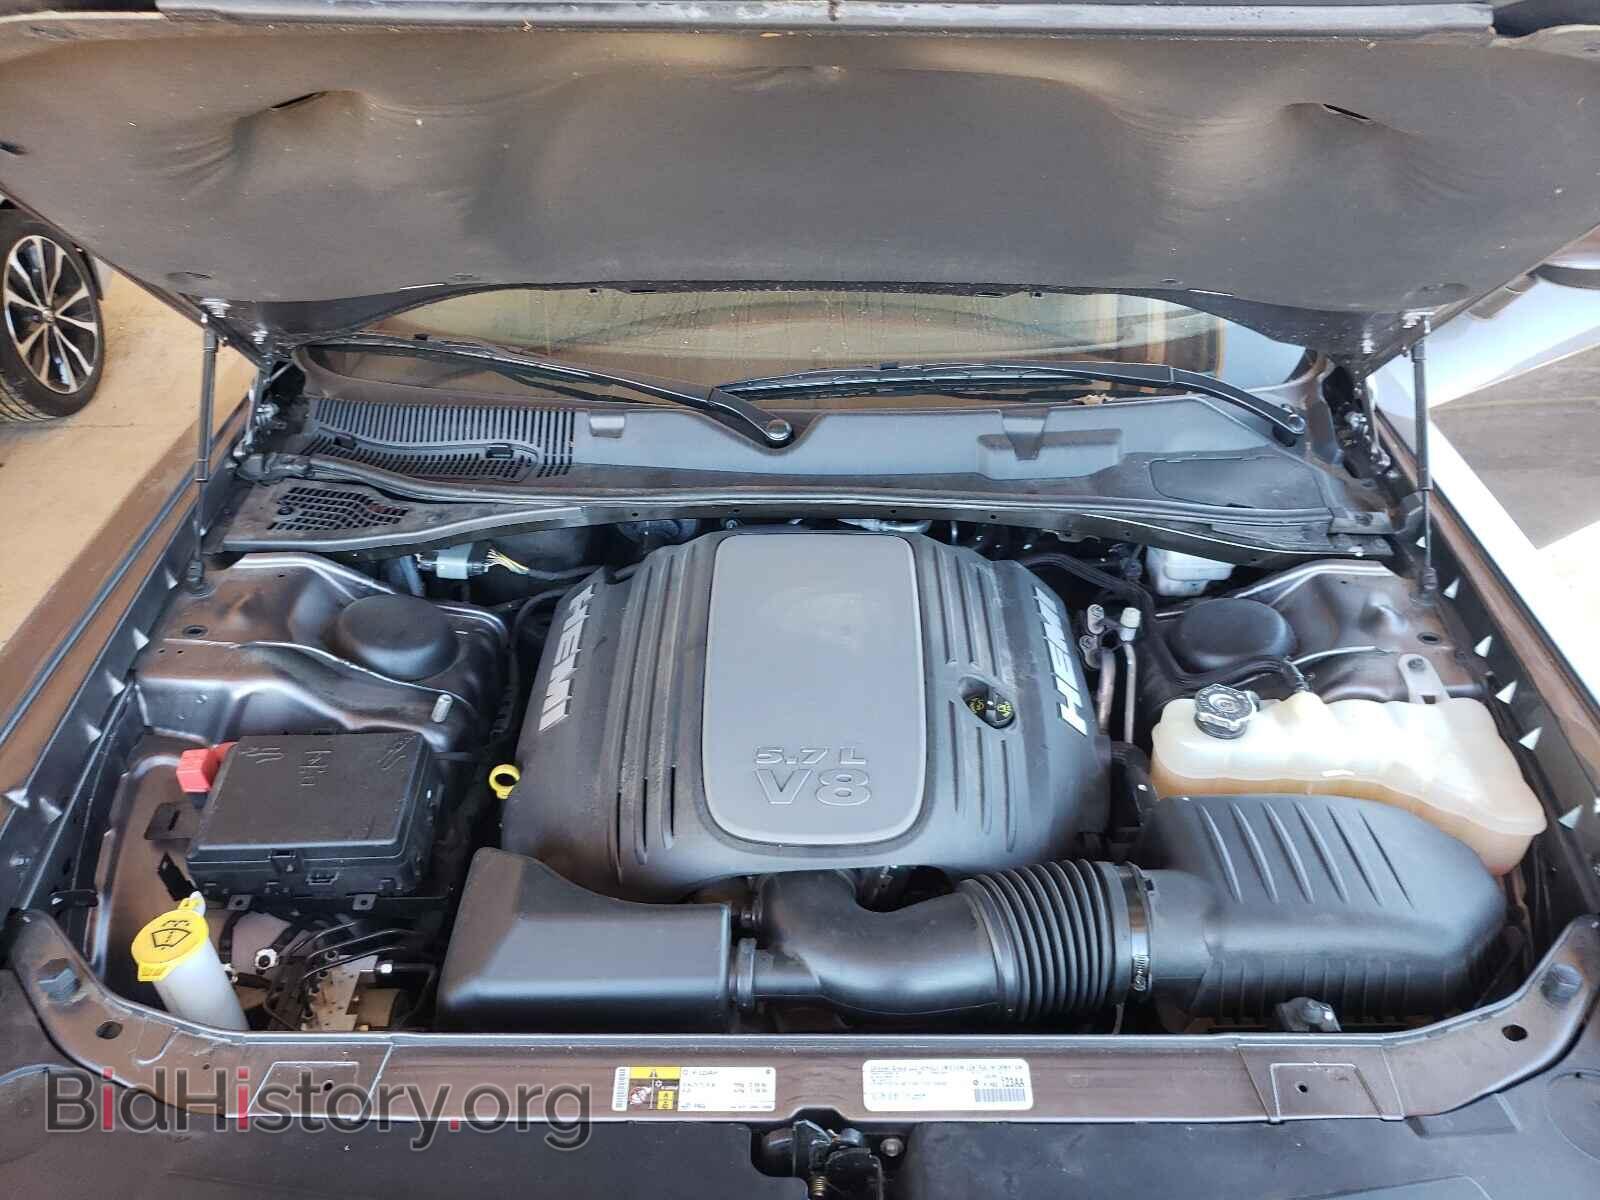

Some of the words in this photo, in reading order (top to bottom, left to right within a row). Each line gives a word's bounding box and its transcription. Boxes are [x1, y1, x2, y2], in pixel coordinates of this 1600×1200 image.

[538, 584, 596, 732] HEMI
[1032, 586, 1088, 737] HEMI
[755, 768, 872, 806] V8
